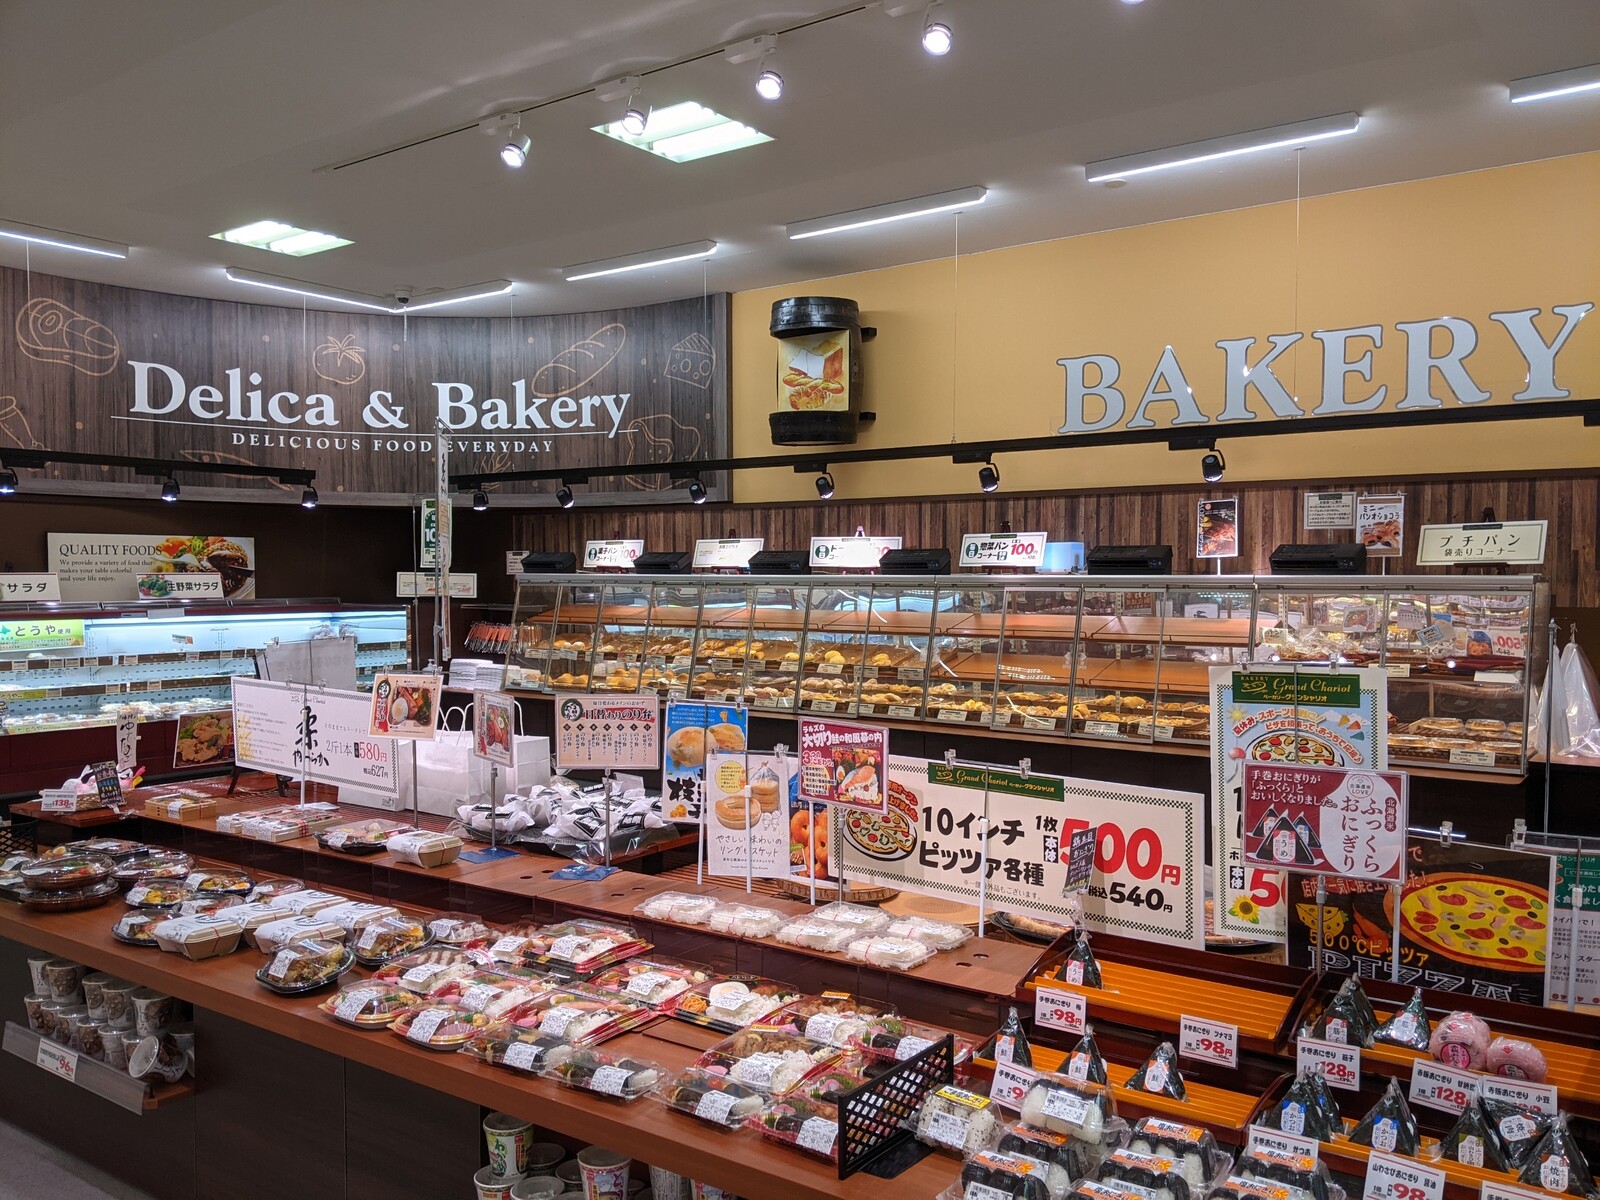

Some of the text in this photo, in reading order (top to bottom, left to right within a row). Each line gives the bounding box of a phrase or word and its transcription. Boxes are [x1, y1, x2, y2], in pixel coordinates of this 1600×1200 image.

[1057, 302, 1593, 435] BAKERY
[127, 360, 630, 438] Delica & Bakery
[232, 432, 553, 453] DELICIOUS FOOD EVERYDAY
[59, 544, 162, 556] QUALITY FOODS
[1440, 534, 1521, 548] プチパン
[1444, 547, 1516, 557] 袋売りコーナー
[7, 582, 48, 593] サラダ
[168, 581, 219, 592] 生野菜サラダ
[15, 625, 56, 636] とうや
[1273, 678, 1351, 694] Grand Chariot
[585, 709, 653, 720] 日替わりのり弁
[326, 740, 353, 756] 2斤1本
[360, 742, 387, 762] 580円
[957, 770, 1008, 785] Grand Chariot
[1251, 770, 1321, 783] 手巻おにぎりが
[1251, 780, 1304, 793] 「ふっくら」と
[1251, 792, 1338, 809] おいしくなりました。
[922, 806, 1026, 847] 10インチ
[1036, 815, 1058, 833] 1枚
[1341, 795, 1360, 872] おにぎり
[1361, 798, 1383, 873] ふっくら
[1044, 836, 1058, 863] 本体
[1281, 840, 1288, 857] うめ
[919, 839, 1045, 887] ピッツァ各種
[1231, 867, 1244, 889] 本体
[963, 879, 1042, 900] ※一部外品もございます。
[1089, 882, 1173, 914] 税込540円
[1054, 1009, 1082, 1025] 98円
[1214, 1031, 1232, 1040] ツナマヨ
[1200, 1038, 1232, 1057] 98円
[1301, 1047, 1336, 1059] 手巻おにぎり
[1011, 1086, 1024, 1100] 9
[1487, 1086, 1550, 1104] 赤飯おにぎり 小豆
[1289, 1113, 1297, 1131] かつお
[1253, 1136, 1311, 1156] 手巻おにぎり かつお
[1381, 1128, 1389, 1147] かつお
[1372, 1163, 1418, 1183] 山わさびおにぎり
[1550, 1167, 1560, 1188] 焼肉
